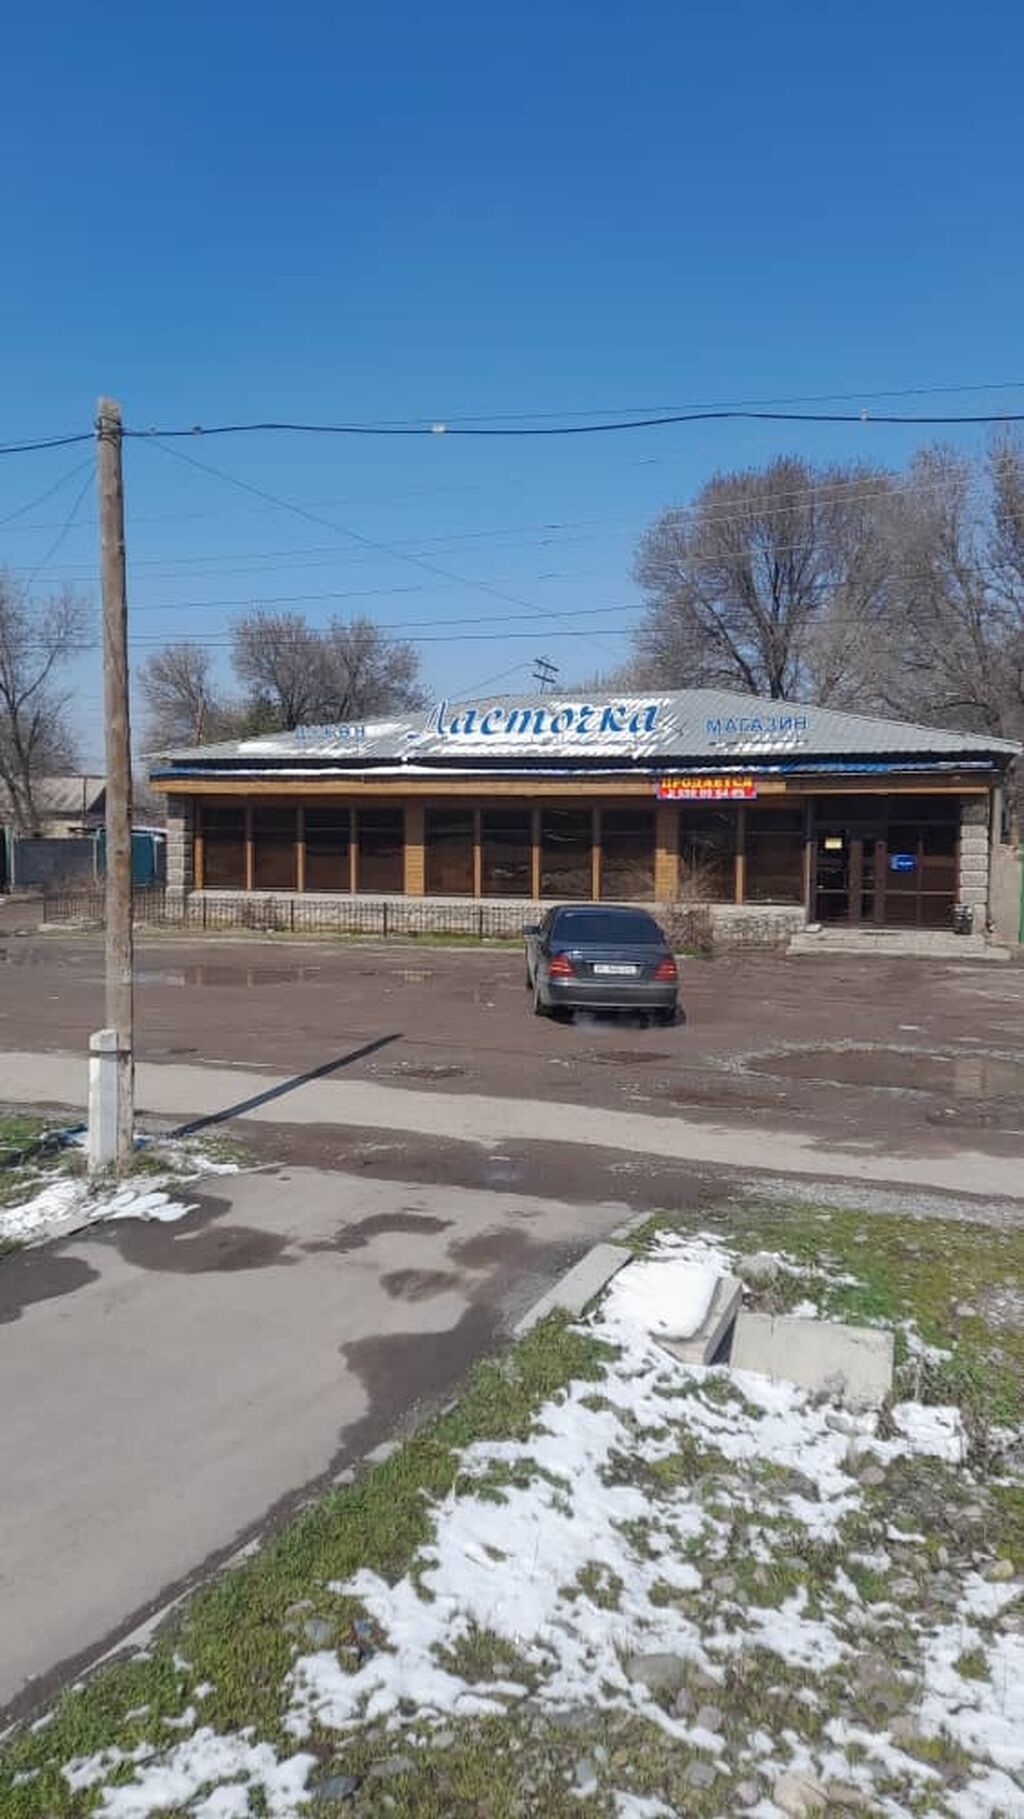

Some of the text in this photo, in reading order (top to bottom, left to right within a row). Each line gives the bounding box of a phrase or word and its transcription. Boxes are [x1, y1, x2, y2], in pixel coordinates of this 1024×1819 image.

[426, 698, 662, 736] Ласточка
[705, 715, 807, 732] МАГАЗИН
[294, 724, 365, 740] ДКӨН
